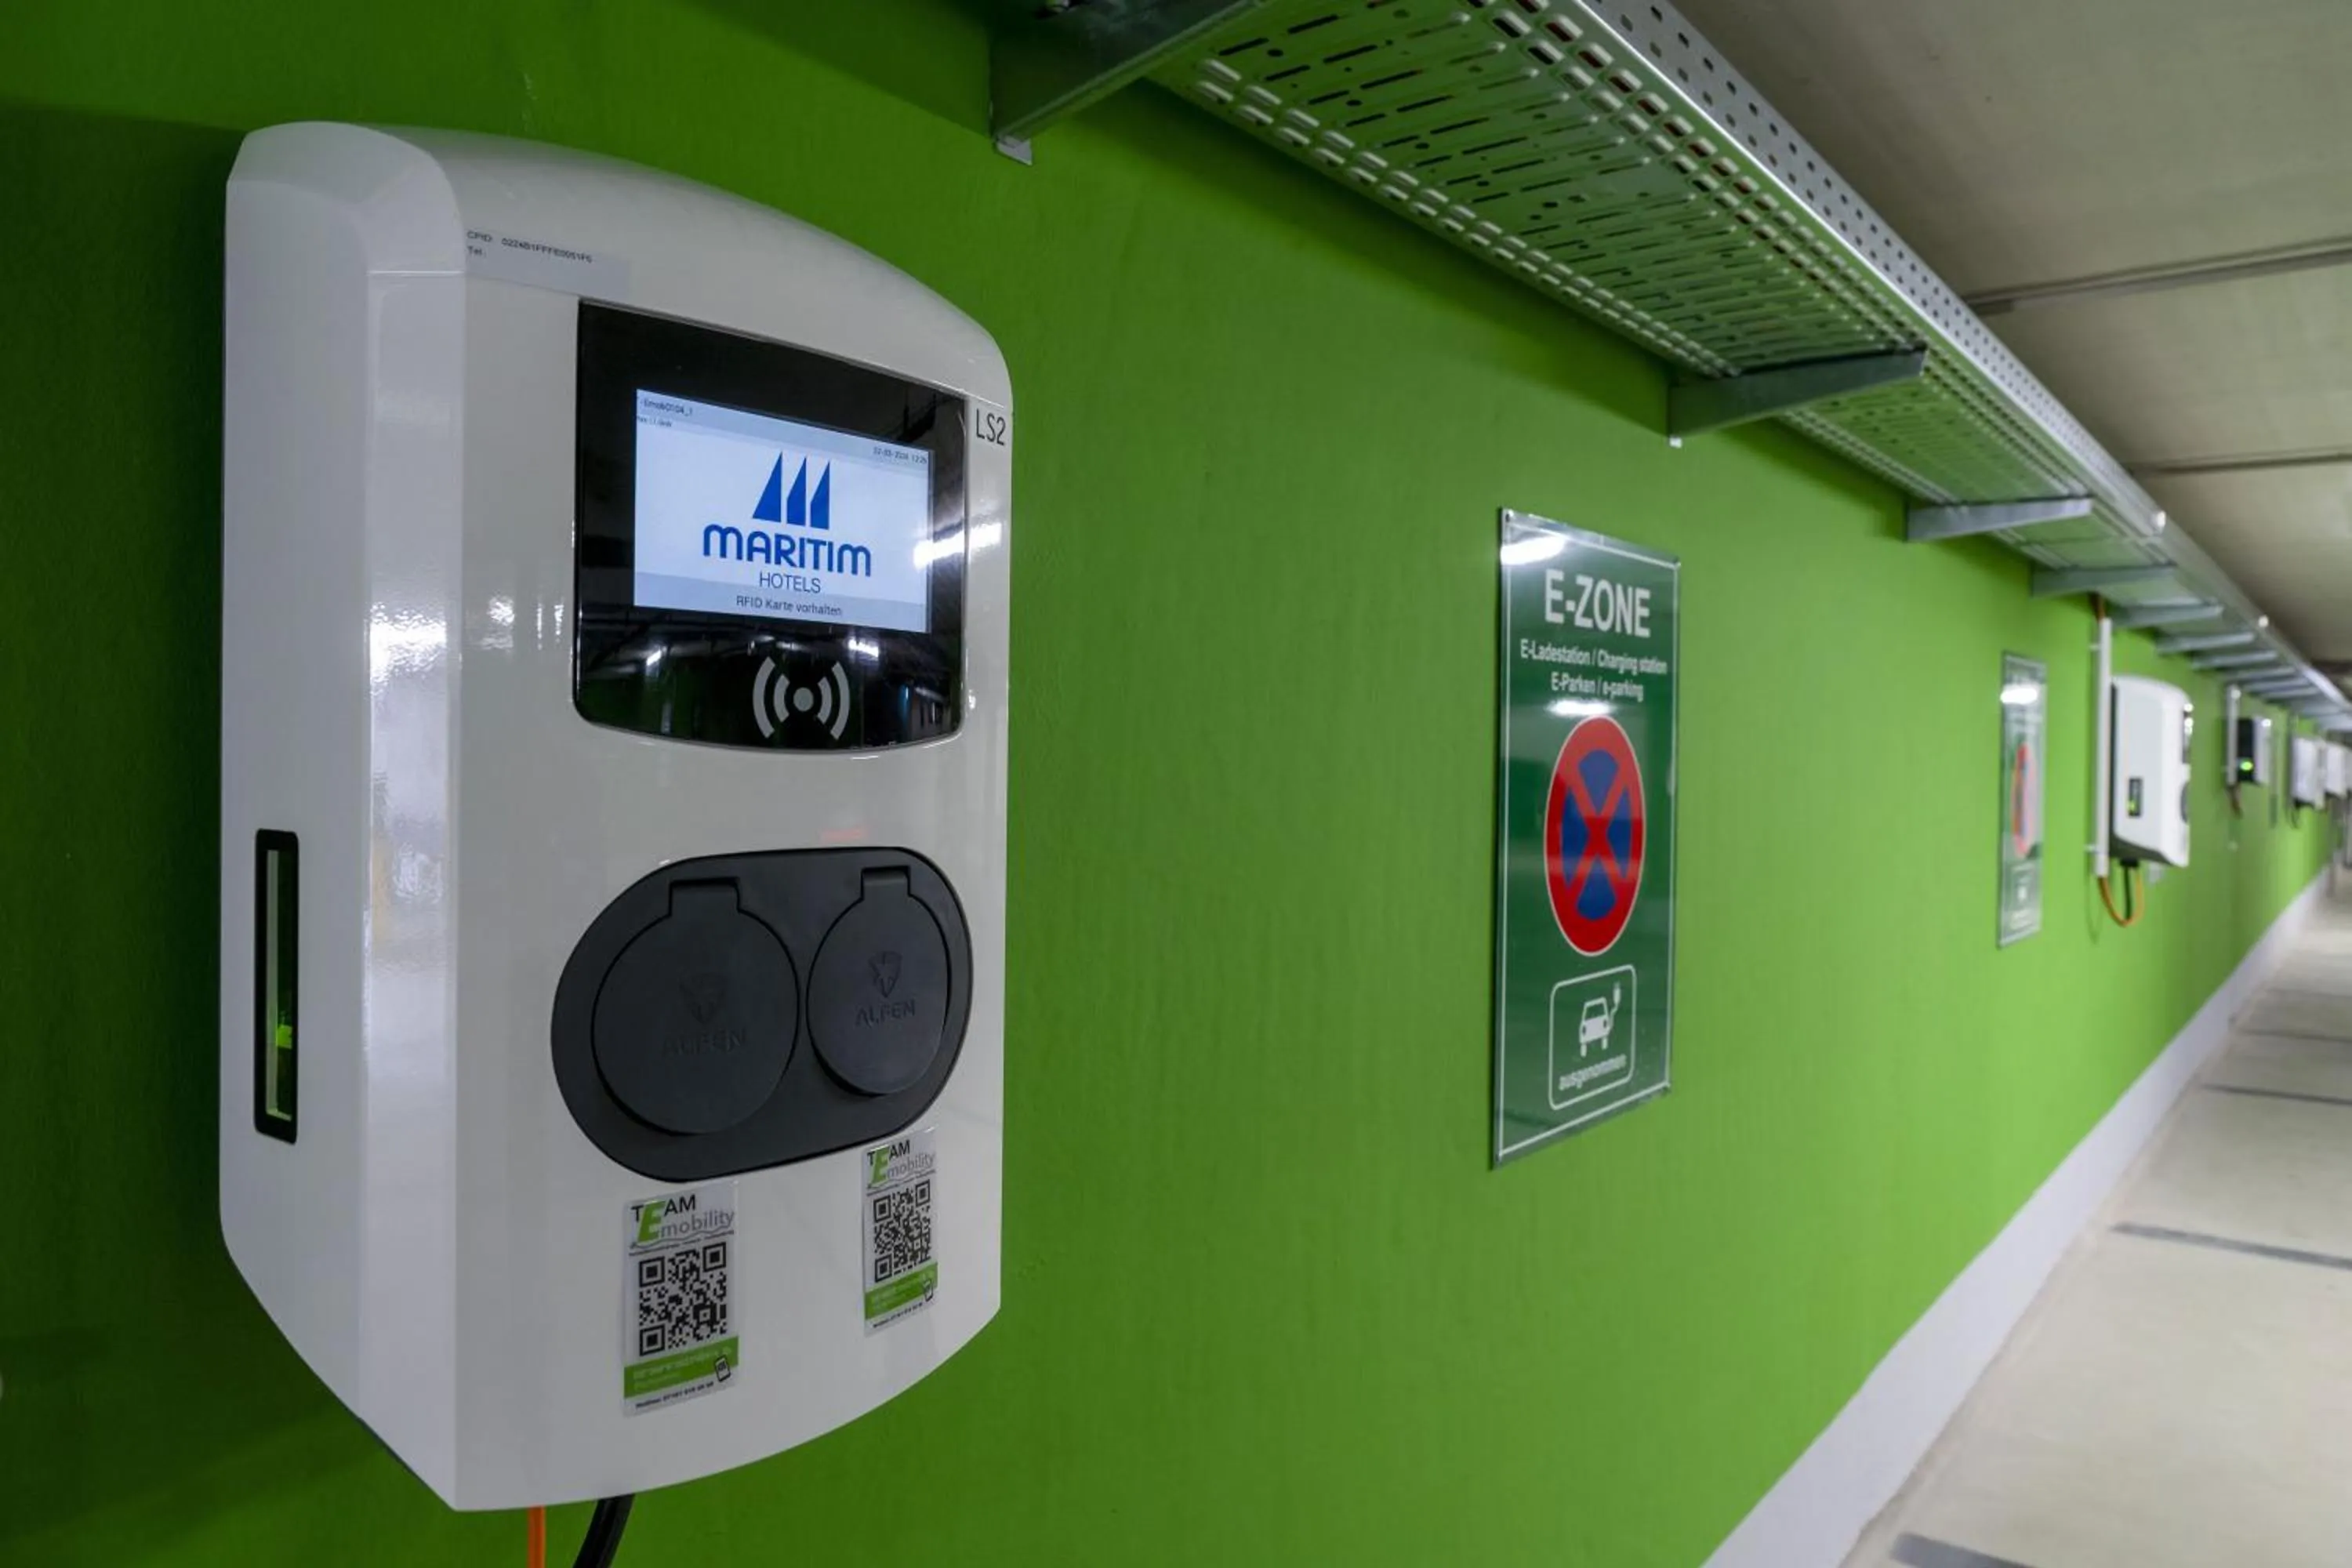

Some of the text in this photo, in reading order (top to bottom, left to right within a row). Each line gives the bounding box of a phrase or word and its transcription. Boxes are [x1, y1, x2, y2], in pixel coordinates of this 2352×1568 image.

[976, 408, 1006, 446] LS2
[702, 524, 871, 577] MARITIM
[759, 571, 822, 594] HOTELS
[735, 594, 843, 617] RFID Karte vorhalten
[1544, 568, 1651, 638] E-ZONE
[1520, 638, 1591, 666] E-Ladestation
[1598, 648, 1638, 676] Charging
[1639, 655, 1668, 675] station
[1551, 671, 1595, 693] E-Parken
[1602, 679, 1644, 702] e-parking
[855, 999, 916, 1029] ALFEN
[661, 1026, 747, 1057] ALFEN
